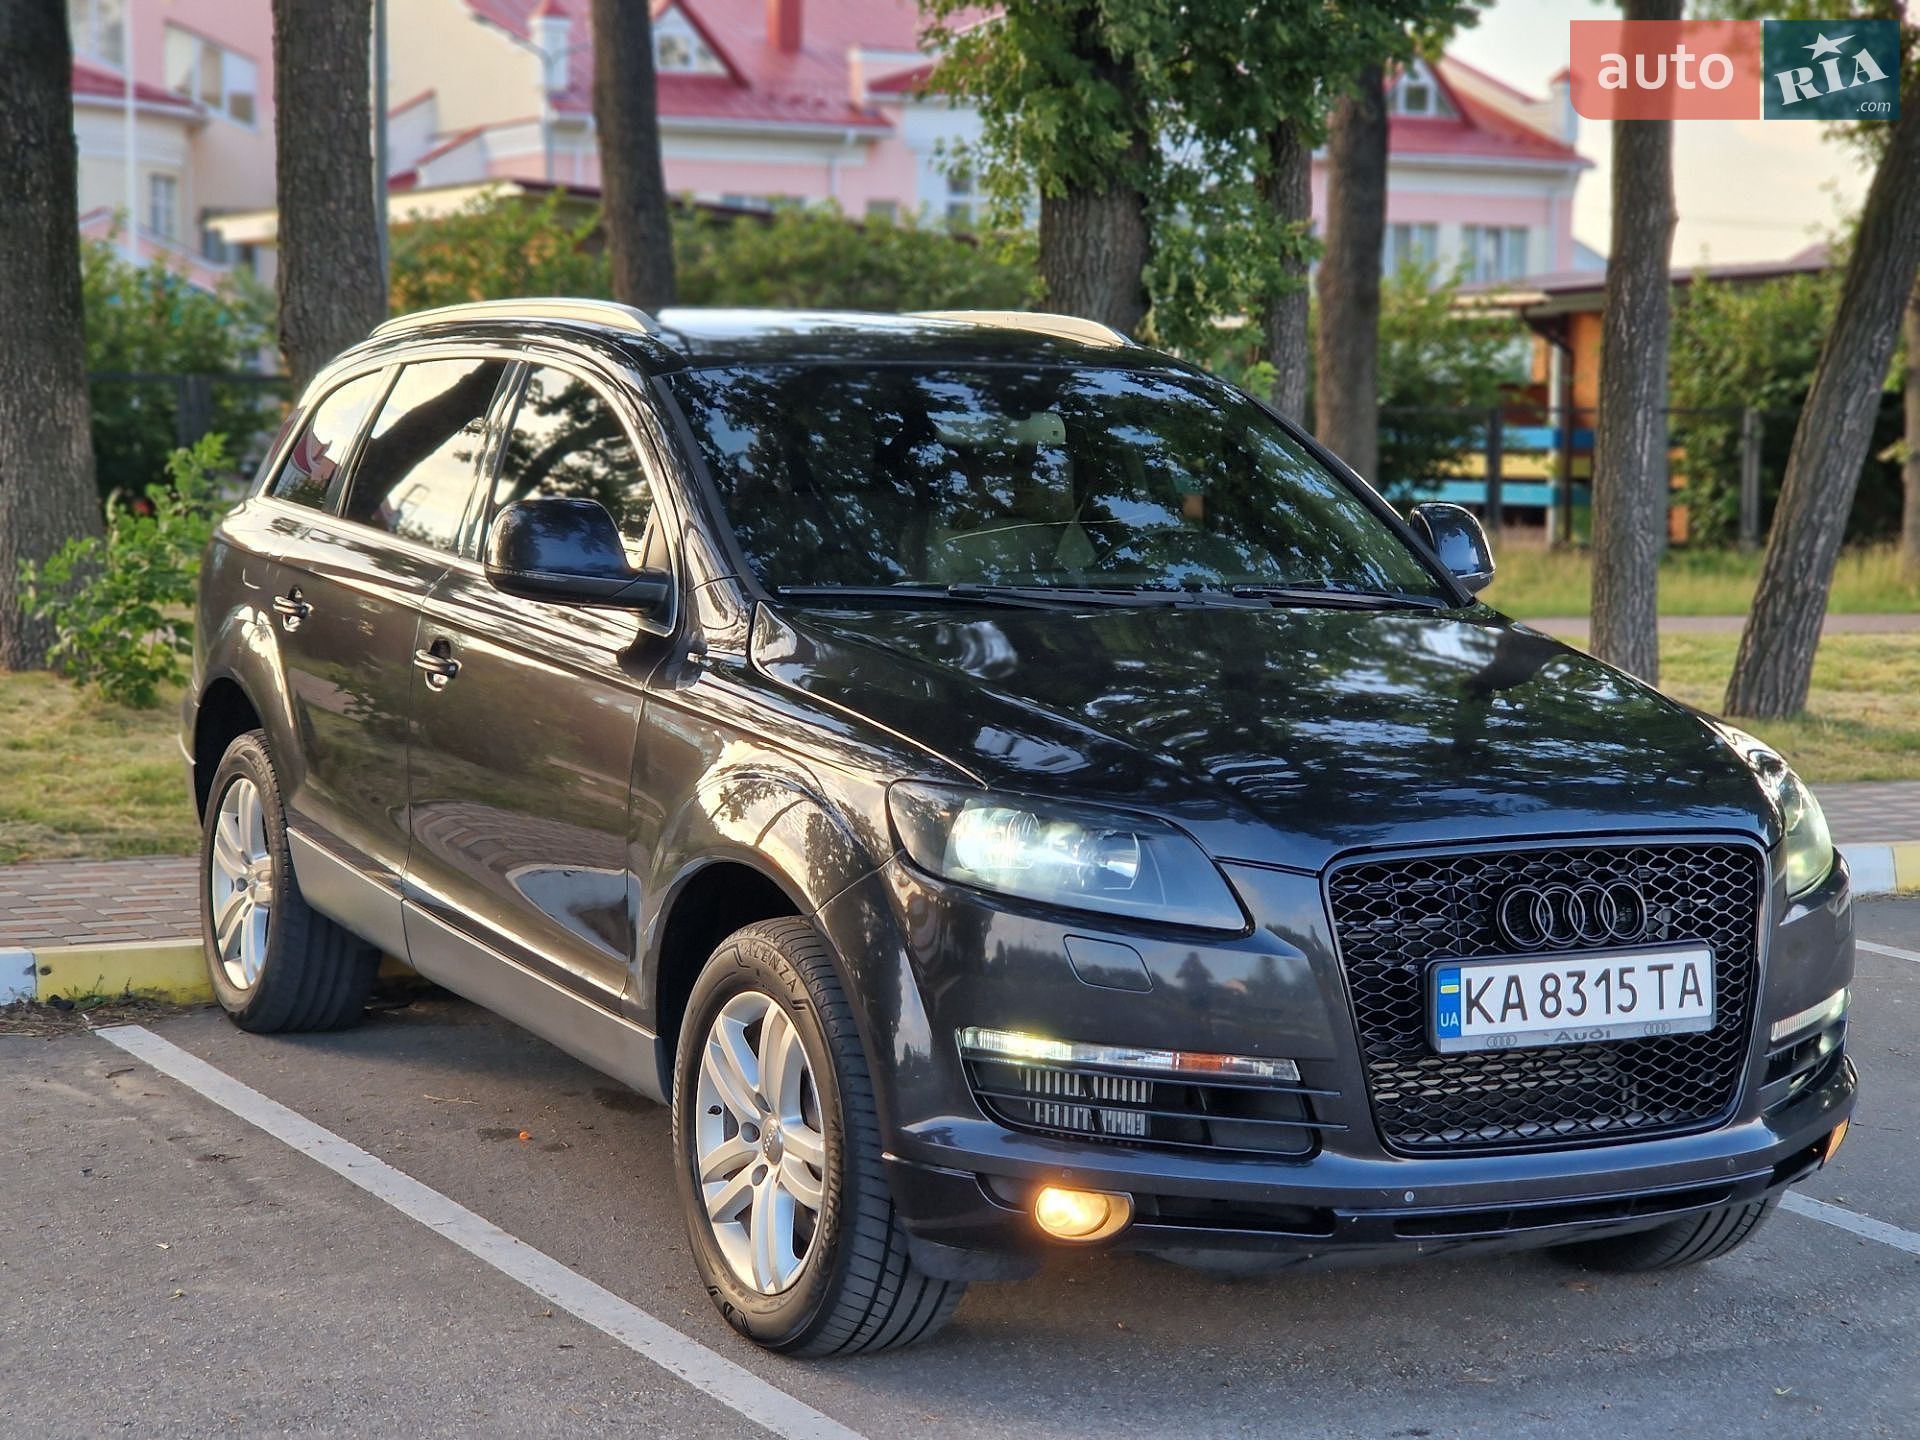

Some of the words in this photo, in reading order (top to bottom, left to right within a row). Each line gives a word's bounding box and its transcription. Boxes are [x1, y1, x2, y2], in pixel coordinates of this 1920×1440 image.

[1465, 975, 1528, 1025] KA
[1540, 966, 1637, 1018] 8315
[1647, 962, 1703, 1009] TA
[1440, 1012, 1459, 1027] UA
[1554, 1029, 1611, 1043] Audi
